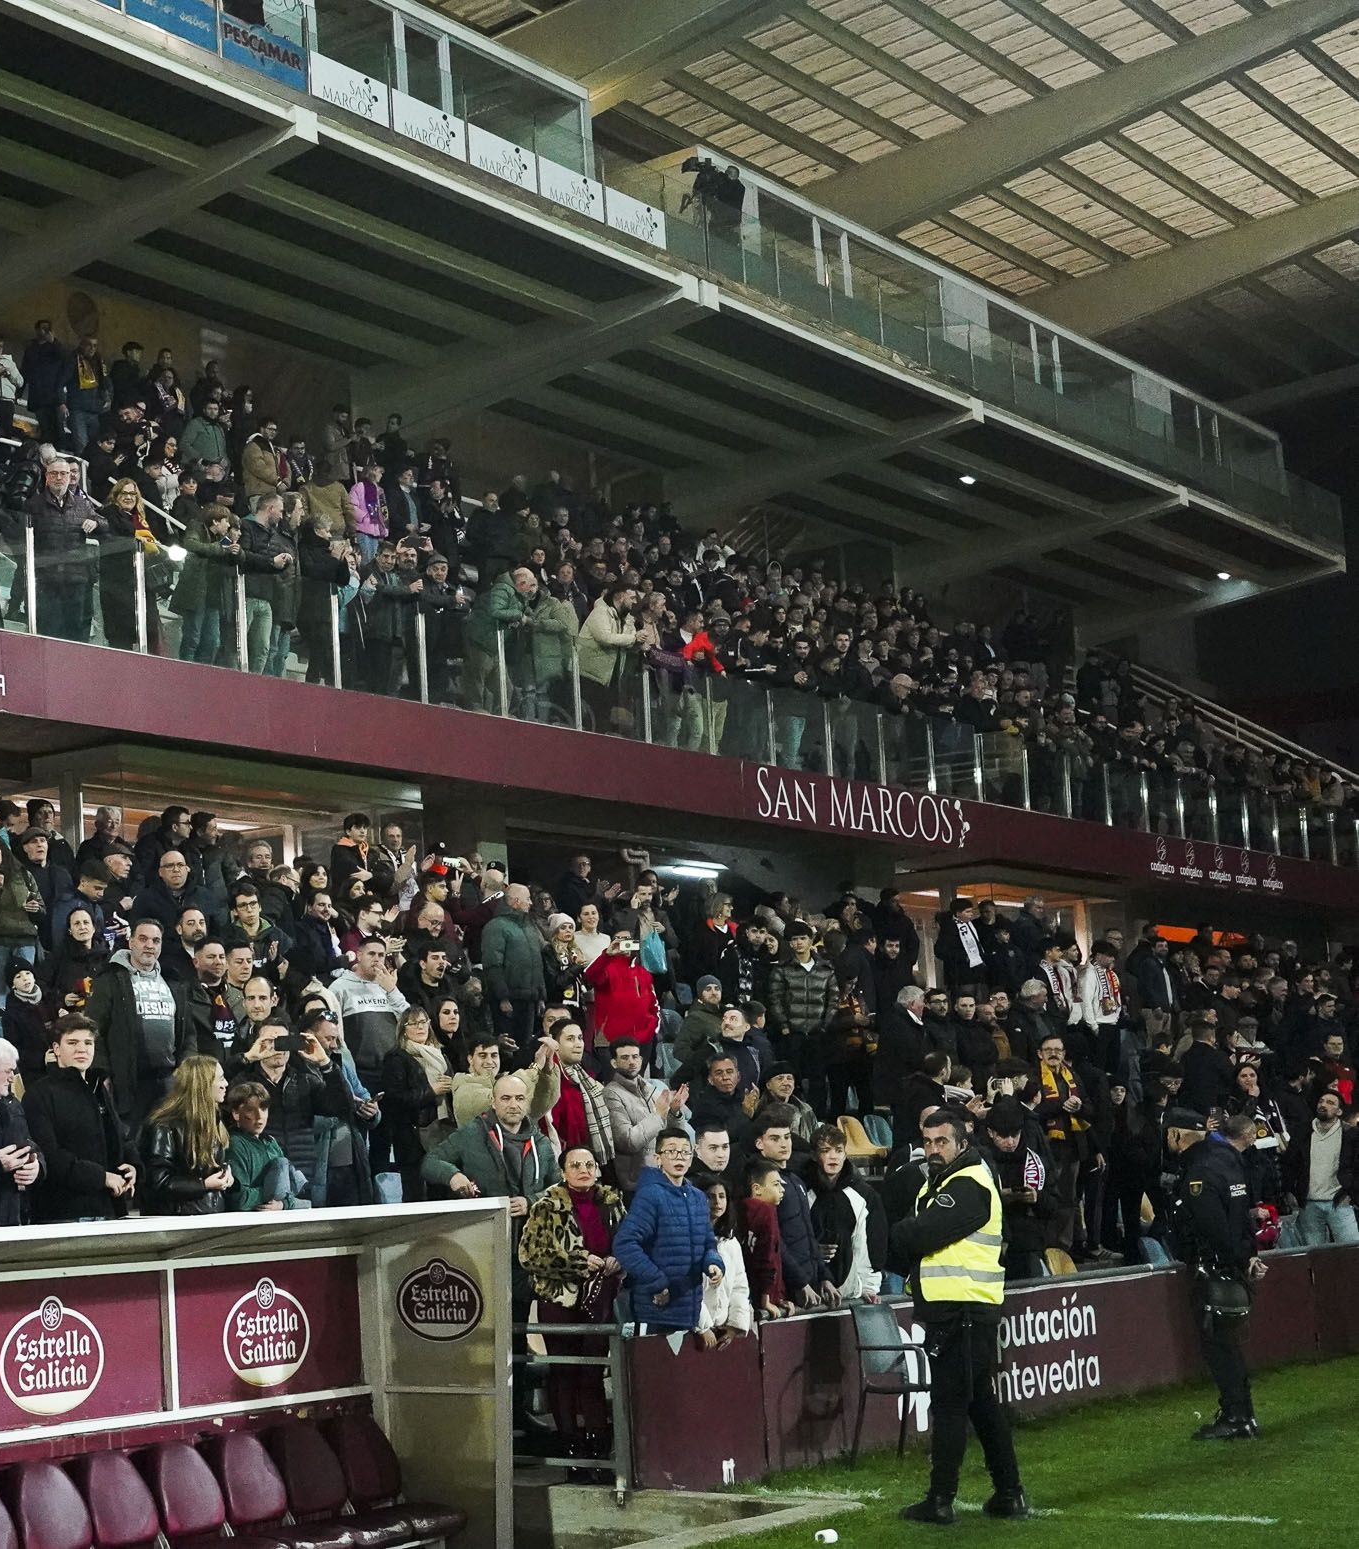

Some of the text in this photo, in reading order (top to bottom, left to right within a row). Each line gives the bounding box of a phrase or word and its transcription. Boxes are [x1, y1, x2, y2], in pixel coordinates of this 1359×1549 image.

[223, 21, 302, 71] PESCAMAR
[322, 85, 373, 118] MARCOS
[349, 80, 372, 99] SAN
[404, 122, 451, 153] MARCOS
[428, 117, 450, 138] SAN
[479, 155, 523, 185] MARCOS
[502, 150, 522, 169] SAN
[549, 187, 591, 215] MARCOS
[571, 181, 591, 200] SAN
[615, 217, 654, 243] MARCOS
[635, 210, 653, 227] SAN
[756, 766, 953, 844] SAN MARCOS
[410, 1284, 469, 1303] Estrella
[235, 1308, 299, 1338] Estrella
[413, 1302, 468, 1321] Galicia
[14, 1329, 91, 1362] Estrella
[239, 1334, 297, 1365] Galicia
[18, 1358, 88, 1392] Galicia
